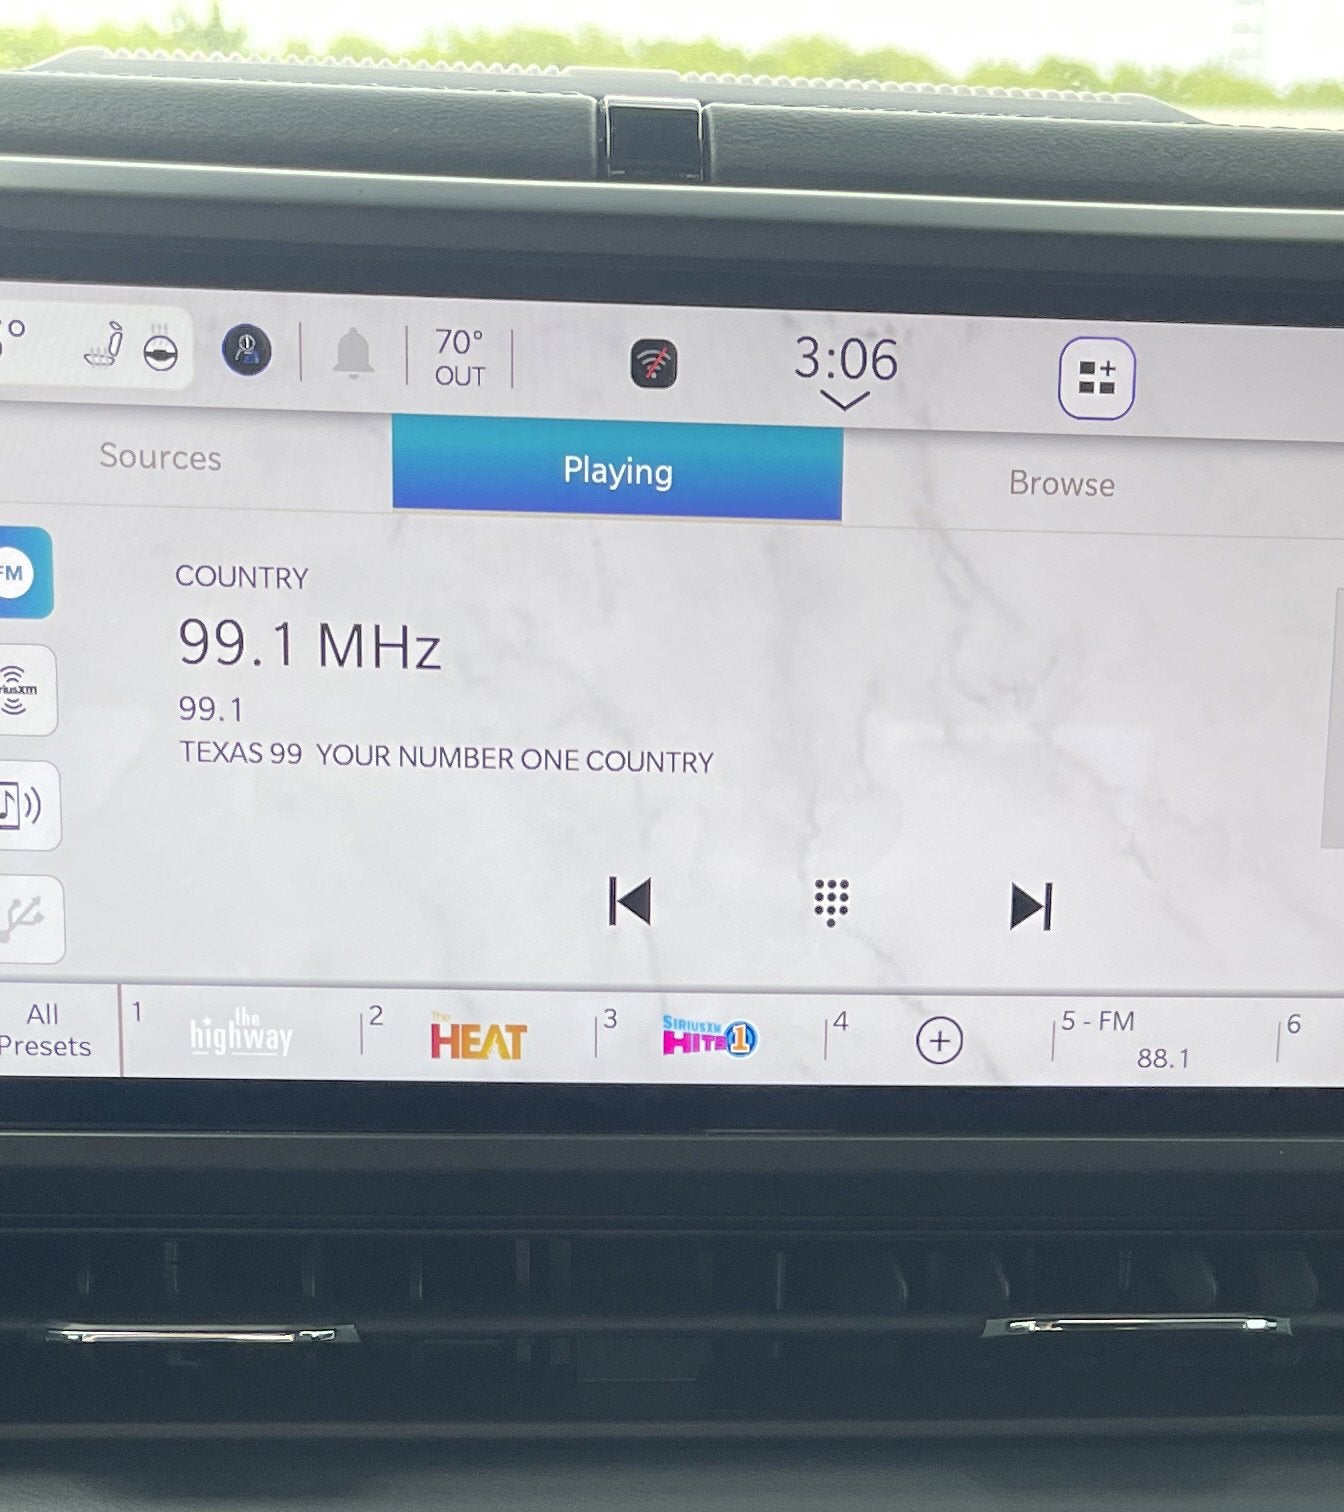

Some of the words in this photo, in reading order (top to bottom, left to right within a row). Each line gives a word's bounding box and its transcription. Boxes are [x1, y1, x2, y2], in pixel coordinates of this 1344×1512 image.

[436, 329, 482, 355] 70°
[795, 336, 897, 380] 3:06
[435, 365, 485, 387] OUT
[99, 443, 222, 471] Sources
[564, 456, 673, 492] Playing
[1009, 469, 1116, 498] Browse
[175, 565, 309, 590] COUNTRY
[179, 618, 293, 667] 99.1
[319, 622, 442, 670] MHz
[178, 696, 243, 722] 99.1
[179, 740, 263, 764] TEXAS
[270, 743, 302, 765] 99
[317, 744, 391, 768] YOUR
[399, 746, 514, 770] NUMBER
[521, 748, 579, 772] ONE
[586, 750, 714, 774] COUNTRY
[26, 1003, 59, 1026] All
[131, 1002, 142, 1022] 1
[235, 1005, 260, 1026] the
[368, 1005, 385, 1026] 2
[602, 1009, 618, 1029] 3
[833, 1010, 849, 1031] 4
[1061, 1010, 1076, 1031] 5
[1099, 1011, 1135, 1031] FM
[1287, 1014, 1301, 1034] 6
[190, 1018, 293, 1056] highway
[431, 1023, 528, 1060] HEAT
[1137, 1048, 1189, 1069] 88.1
